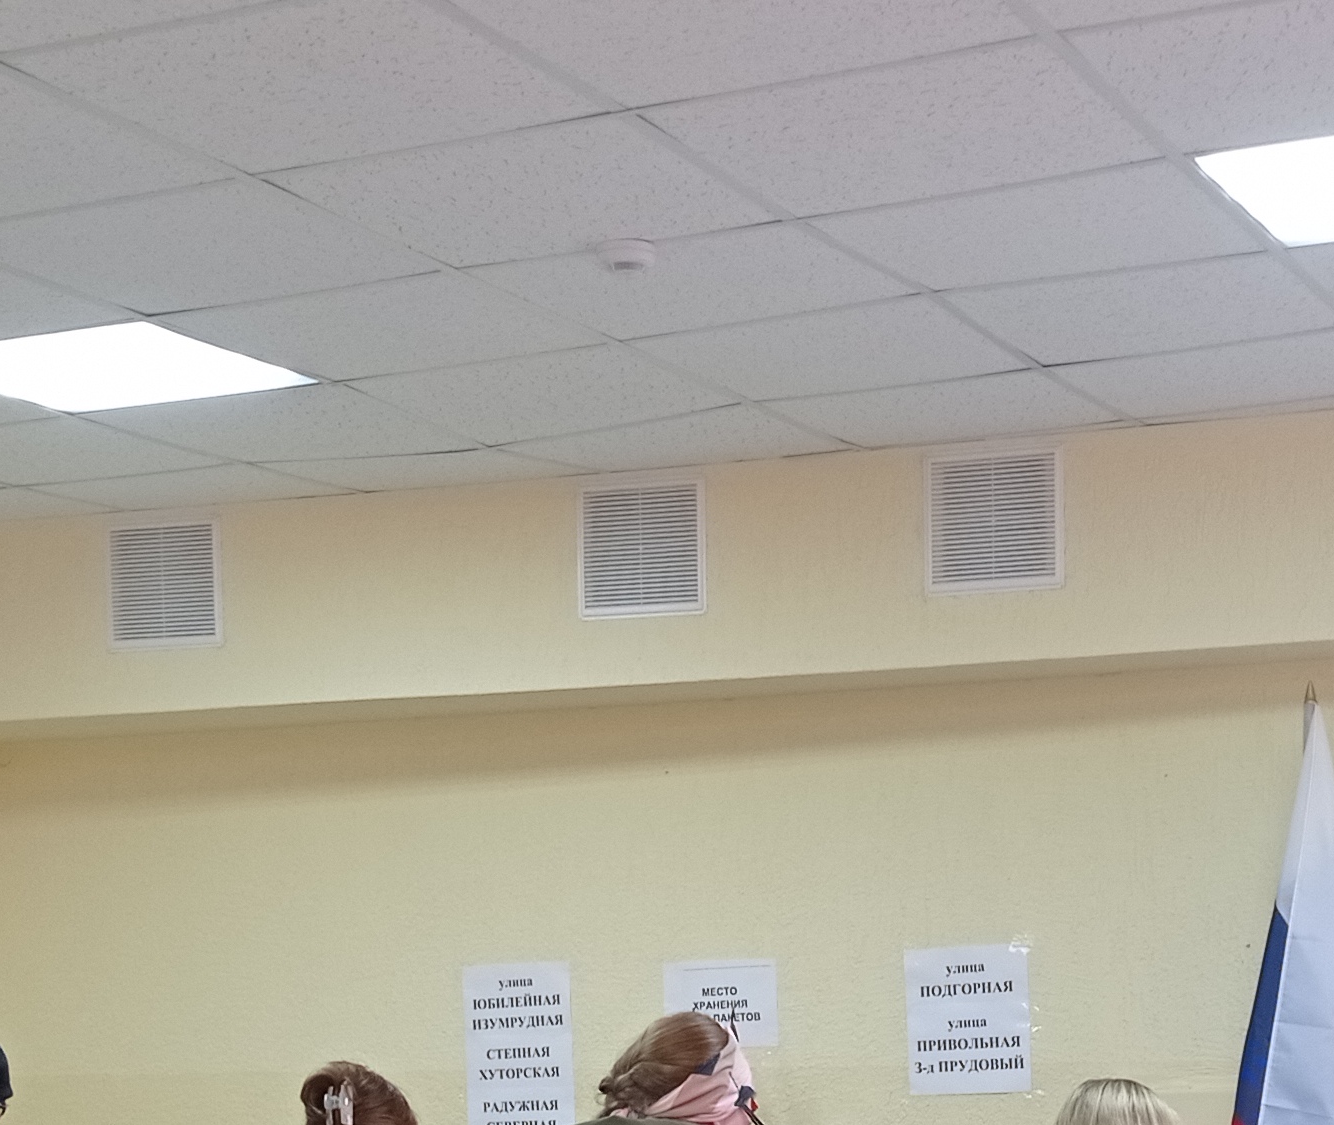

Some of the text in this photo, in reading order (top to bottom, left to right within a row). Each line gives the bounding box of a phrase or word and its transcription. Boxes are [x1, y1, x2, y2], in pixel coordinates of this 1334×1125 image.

[946, 963, 985, 977] улица
[498, 978, 533, 991] улица
[702, 986, 738, 997] МЕСТО
[920, 980, 1013, 998] ПОДГОРНАЯ
[473, 993, 561, 1010] ЮБИЛЕЙНАЯ
[693, 999, 748, 1010] ХРАНЕНИЯ
[472, 1014, 564, 1030] ИЗУМРУДНАЯ
[948, 1018, 987, 1032] улица
[917, 1035, 1021, 1052] ПРИВОЛЬНАЯ
[486, 1046, 550, 1060] СТЕПНАЯ
[938, 1054, 1025, 1073] ПРУДОВЫЙ
[479, 1066, 560, 1081] ХУТОРСКАЯ
[483, 1100, 559, 1114] РАДУЖНАЯ
